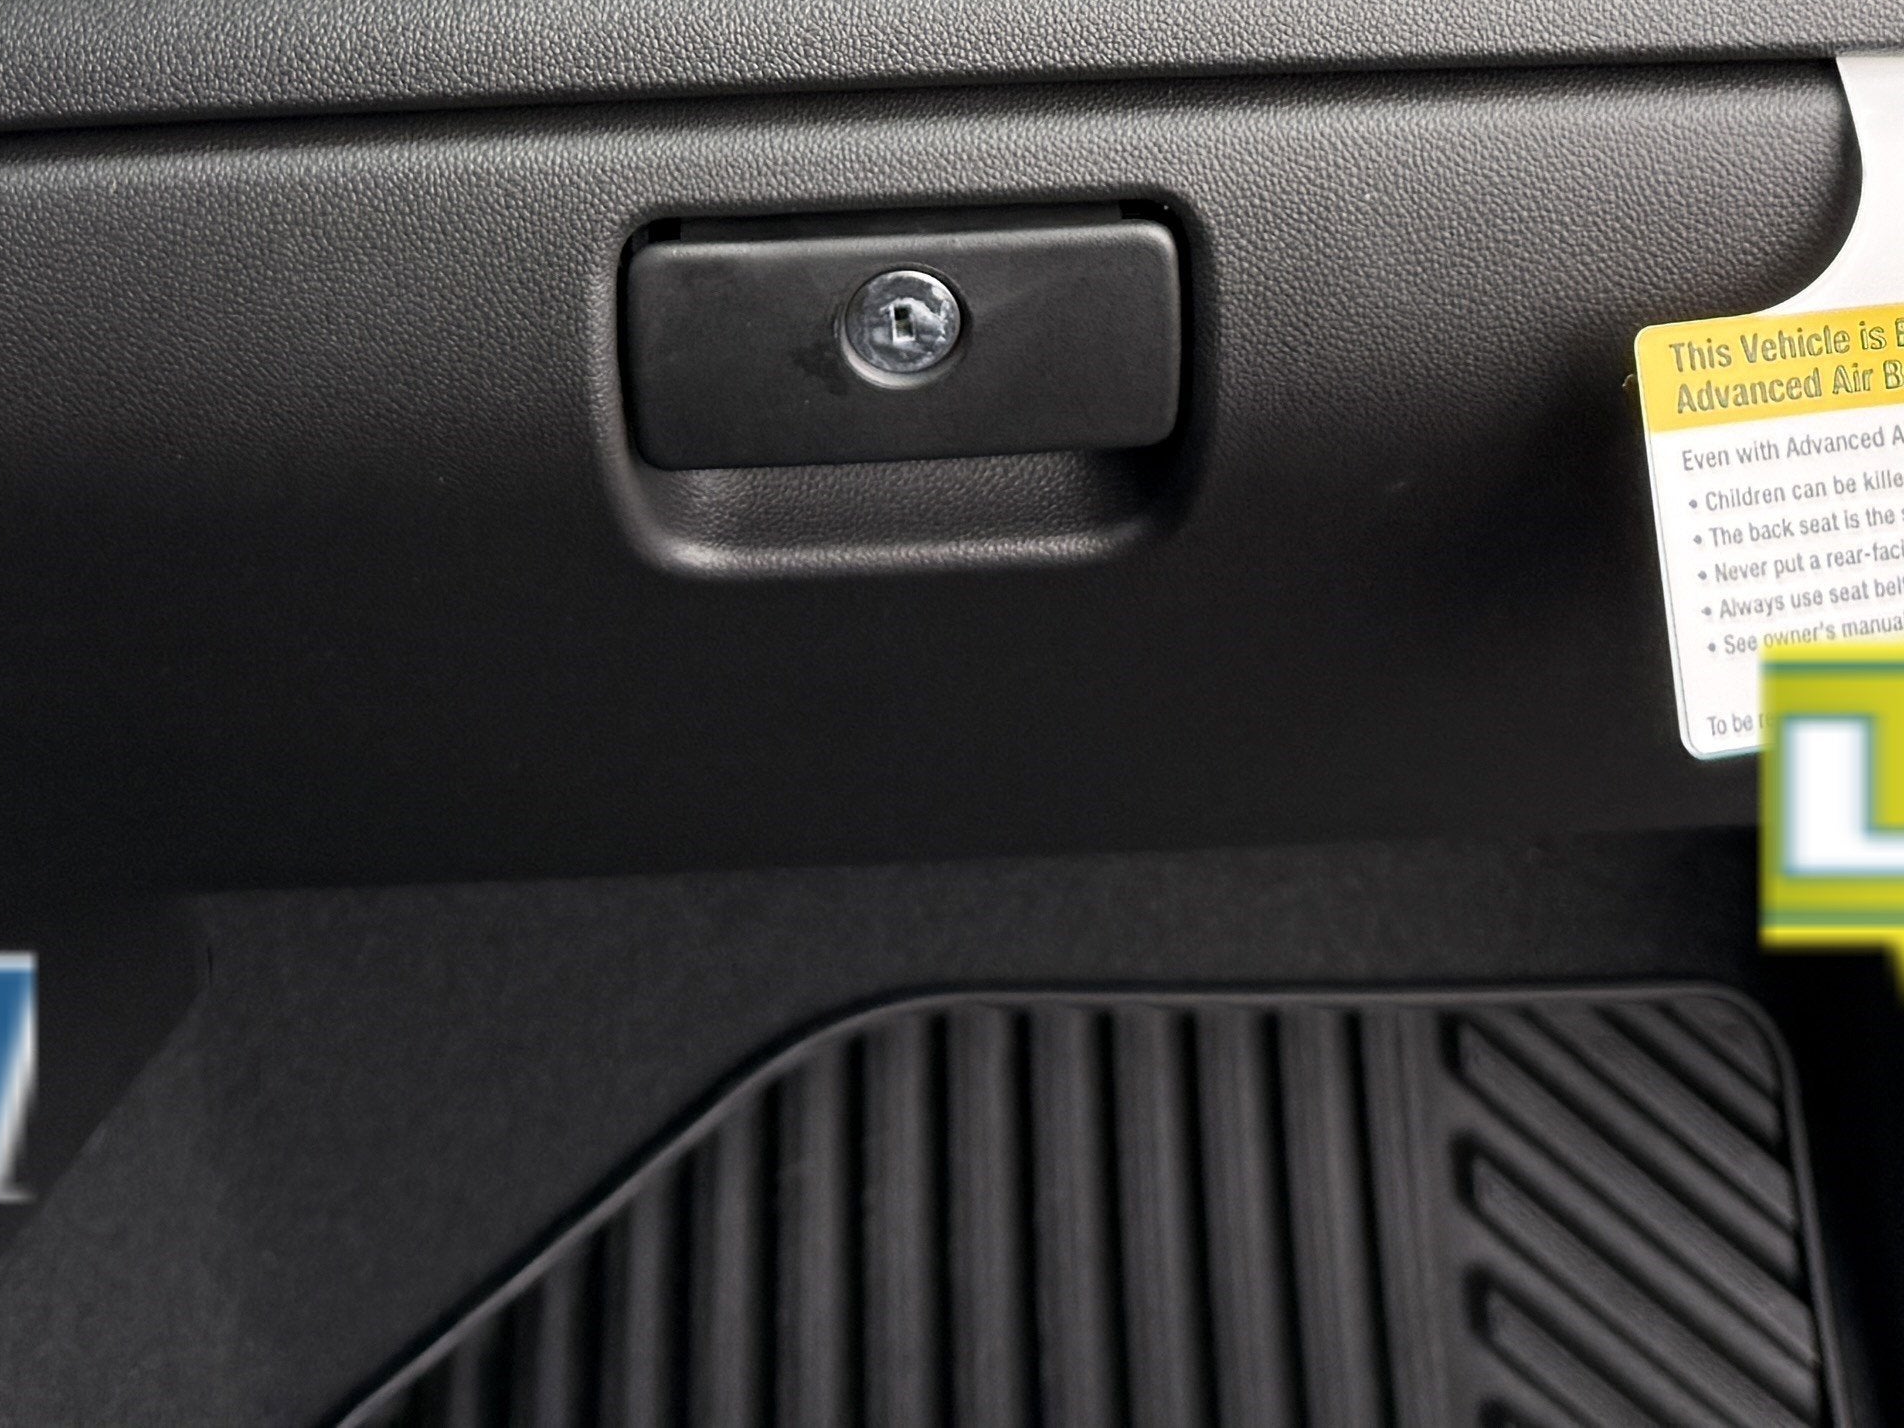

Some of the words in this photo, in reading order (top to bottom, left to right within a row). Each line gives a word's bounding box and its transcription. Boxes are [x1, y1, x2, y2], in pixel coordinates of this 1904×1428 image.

[1669, 337, 1733, 373] This
[1740, 324, 1851, 364] Vehicle
[1859, 320, 1887, 350] is
[1677, 366, 1823, 414] Advanced
[1832, 362, 1874, 394] Air
[1681, 449, 1730, 472] Even
[1736, 440, 1780, 465] with
[1786, 426, 1885, 459] Advanced
[1705, 486, 1786, 512] Children
[1792, 480, 1828, 501] can
[1833, 474, 1857, 495] be
[1709, 526, 1744, 548] The
[1748, 518, 1795, 542] back
[1799, 512, 1840, 536] seat
[1844, 509, 1860, 530] is
[1866, 506, 1896, 528] the
[1714, 560, 1768, 583] Never
[1773, 552, 1805, 580] put
[1809, 553, 1822, 571] a
[1719, 594, 1786, 619] Always
[1790, 589, 1824, 609] use
[1829, 579, 1870, 604] seat
[1723, 633, 1759, 655] See
[1763, 621, 1837, 649] owner's
[1706, 715, 1728, 737] To
[1731, 712, 1754, 733] be
